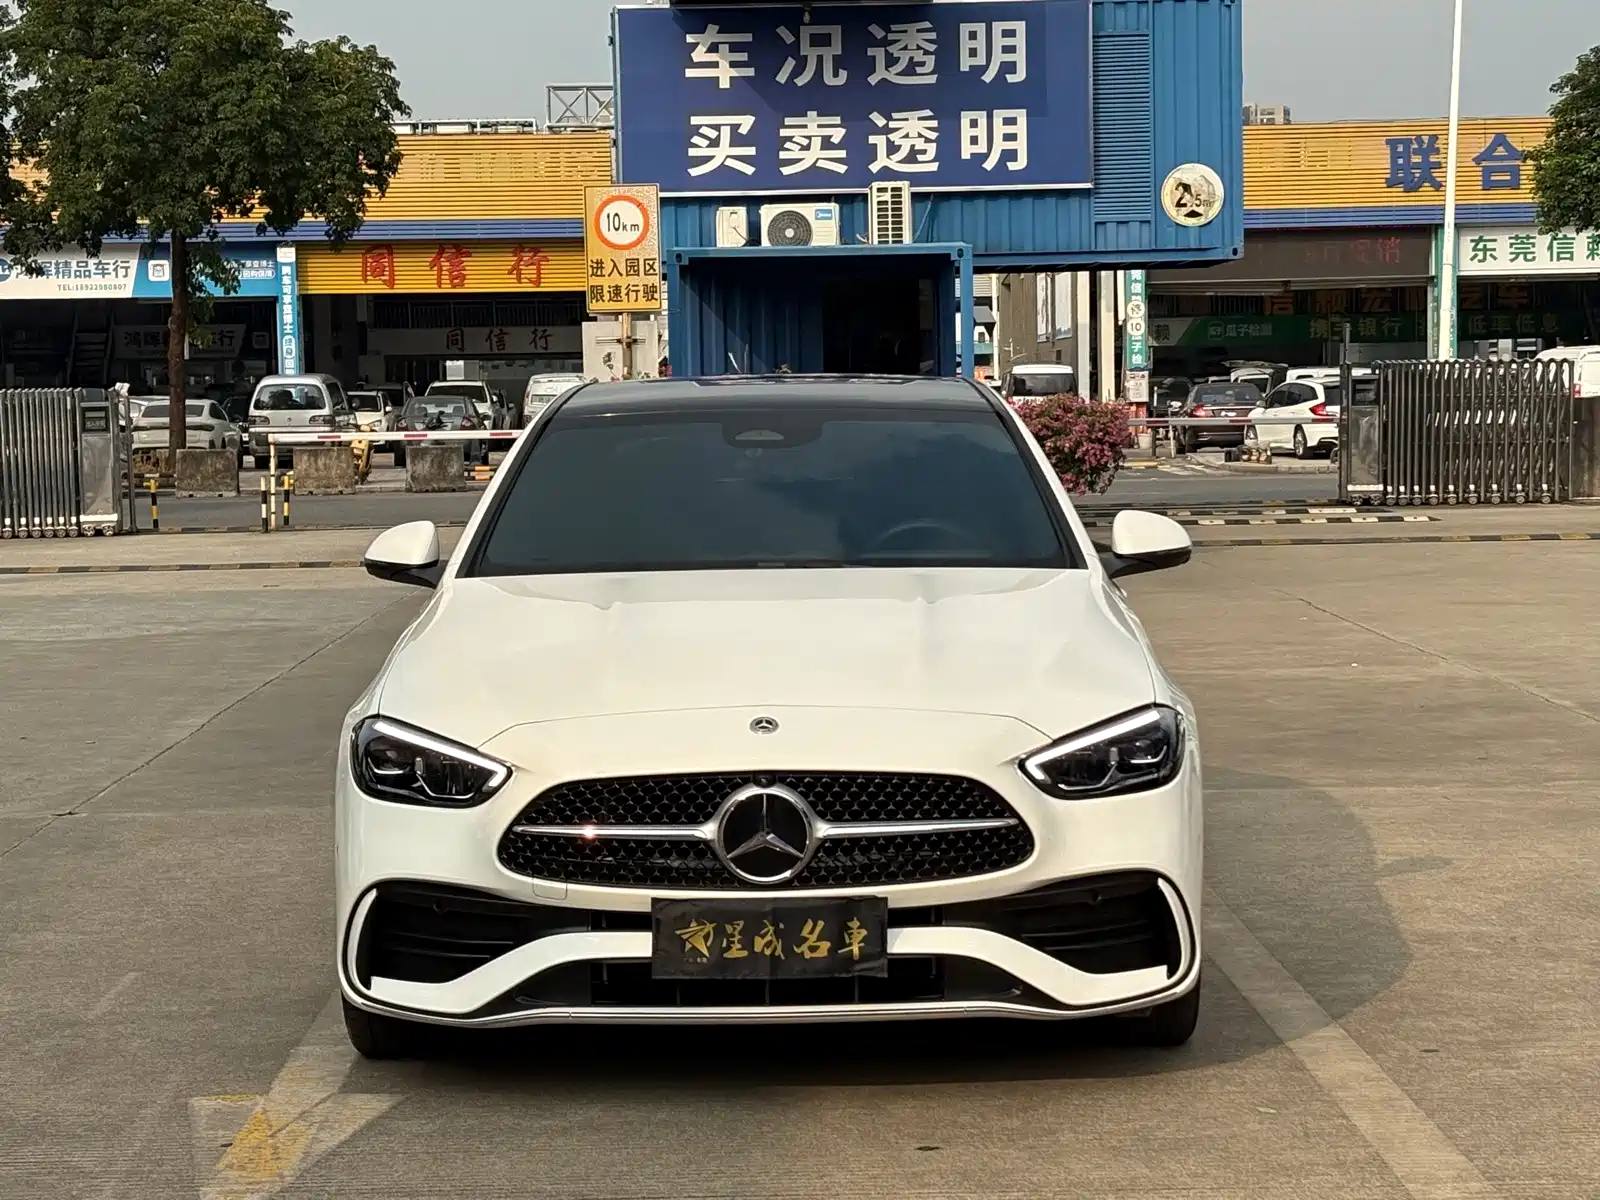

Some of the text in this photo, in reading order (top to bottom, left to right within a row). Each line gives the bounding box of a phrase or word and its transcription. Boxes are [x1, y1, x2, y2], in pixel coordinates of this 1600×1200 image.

[685, 20, 1027, 89] 车况透明
[686, 108, 1028, 177] 买卖透明
[1385, 133, 1525, 192] 联合
[361, 243, 551, 289] 同信行
[589, 258, 658, 278] 进入园区
[589, 283, 659, 304] 限速行驶
[446, 327, 553, 352] 同信行
